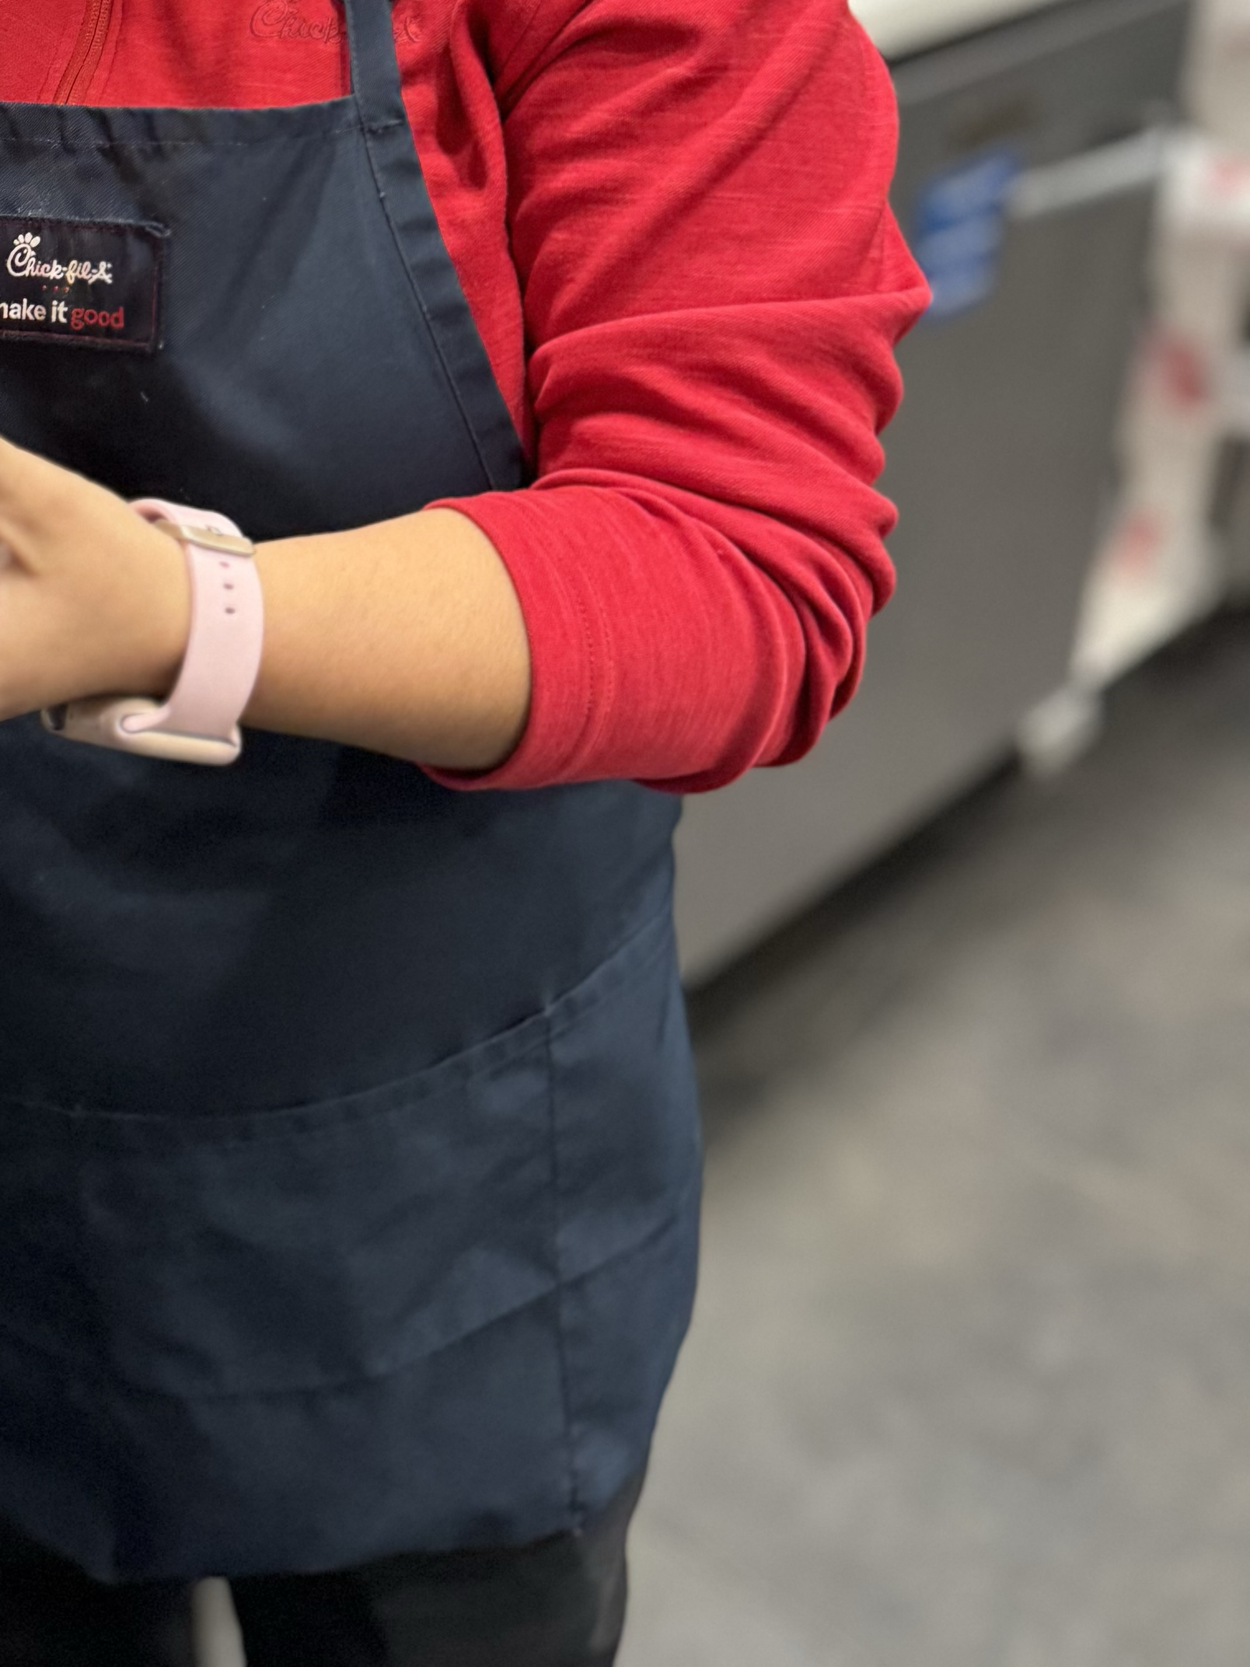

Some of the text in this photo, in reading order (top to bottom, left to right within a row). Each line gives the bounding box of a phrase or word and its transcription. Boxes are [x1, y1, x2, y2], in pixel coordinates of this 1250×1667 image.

[6, 238, 113, 285] Chick-fil-A
[51, 299, 69, 324] it
[70, 305, 125, 331] good
